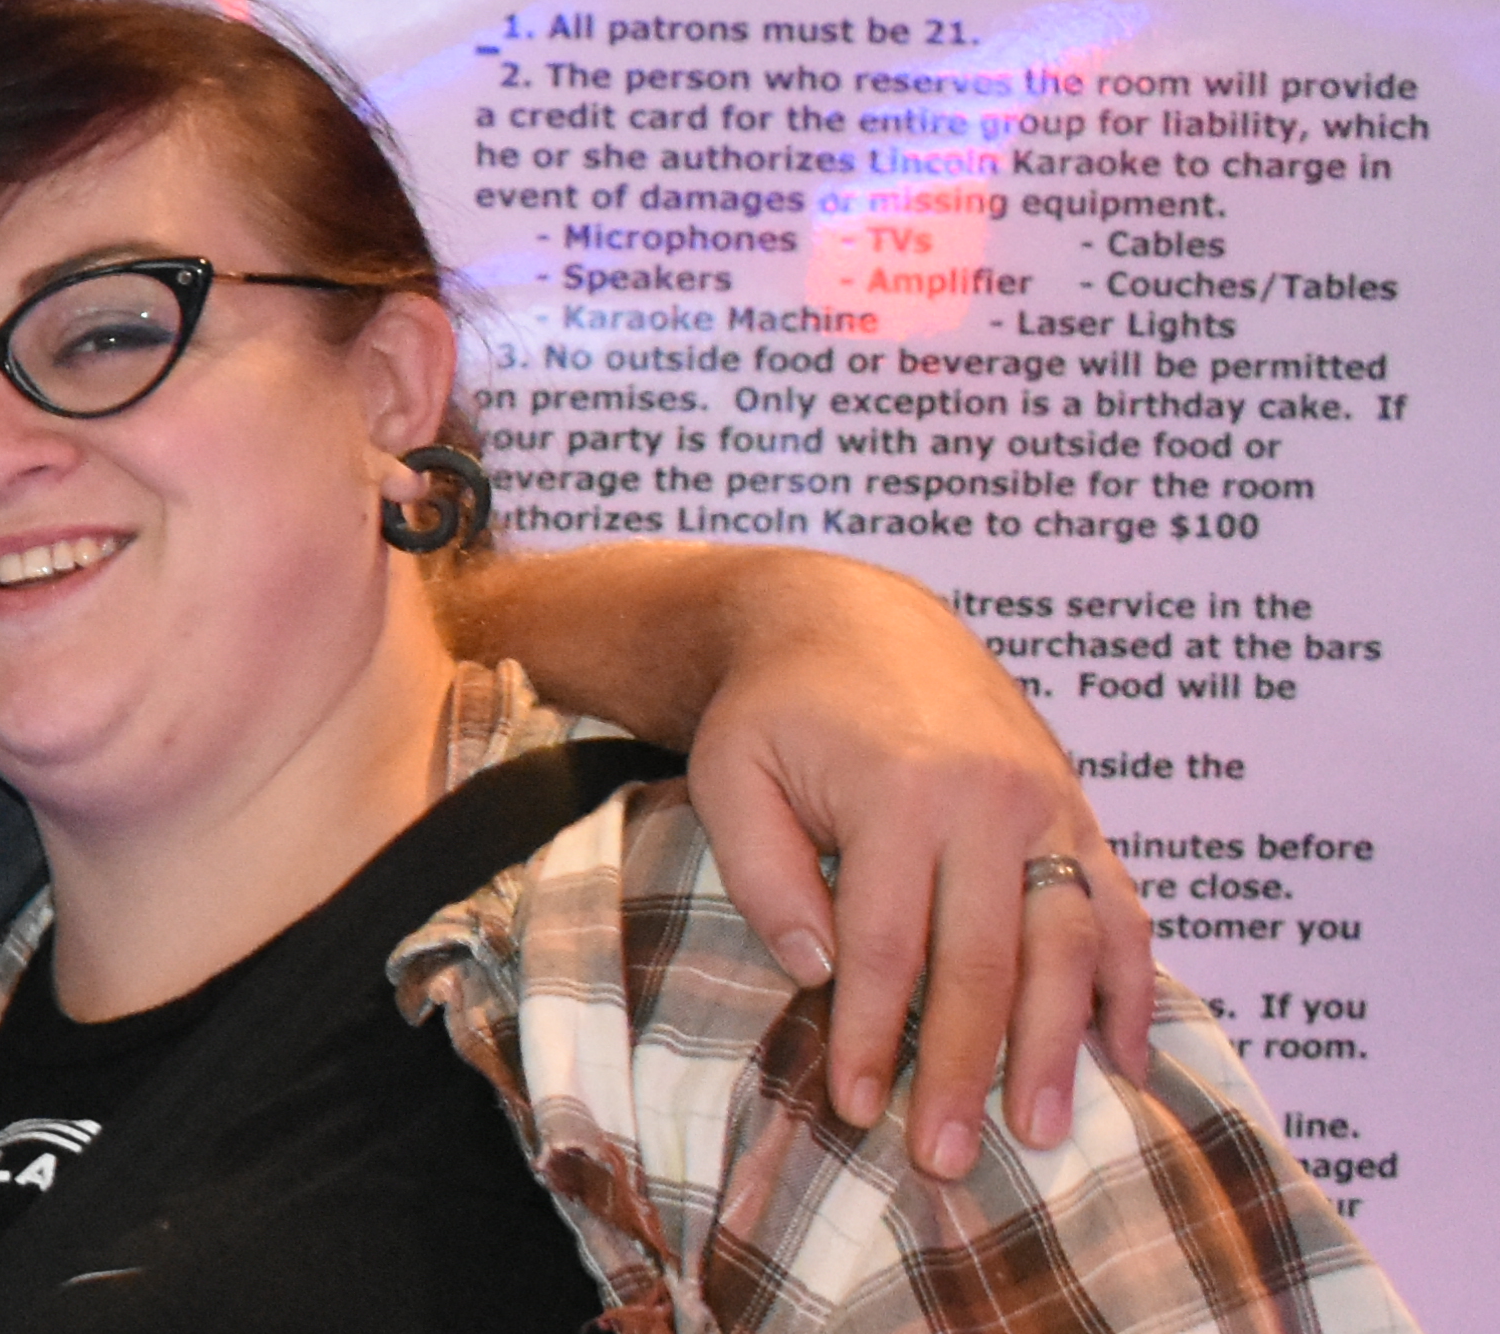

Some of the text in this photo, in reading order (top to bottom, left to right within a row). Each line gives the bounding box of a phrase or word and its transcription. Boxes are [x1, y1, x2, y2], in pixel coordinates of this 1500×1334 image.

[502, 10, 981, 48] 1. All patrons must be 21.
[497, 60, 1420, 104] 2. The person who room will provide
[472, 102, 1432, 145] a credit card for the group for liability, which
[473, 139, 1394, 188] he or she authorizes Karaoke to charge in
[472, 182, 1228, 224] event of damages equipment.
[562, 222, 1228, 260] Microphones TVs Cables
[560, 262, 1400, 306] Speakers Amplifier Couches/Tables
[726, 303, 1239, 344] Machine Laser Lights
[495, 342, 1389, 385] 3. No outside food or beverage will be permitted
[472, 384, 1411, 426] on premises. Only exception is a birthday cake. If
[1063, 588, 1198, 620] service
[984, 629, 1384, 664] purchased bars
[1075, 670, 1299, 703] Food will be
[1105, 829, 1376, 864] minutes before
[1187, 872, 1295, 902] close.
[1258, 989, 1369, 1026] If you
[1261, 1036, 1369, 1062] room.
[1282, 1109, 1362, 1141] line.
